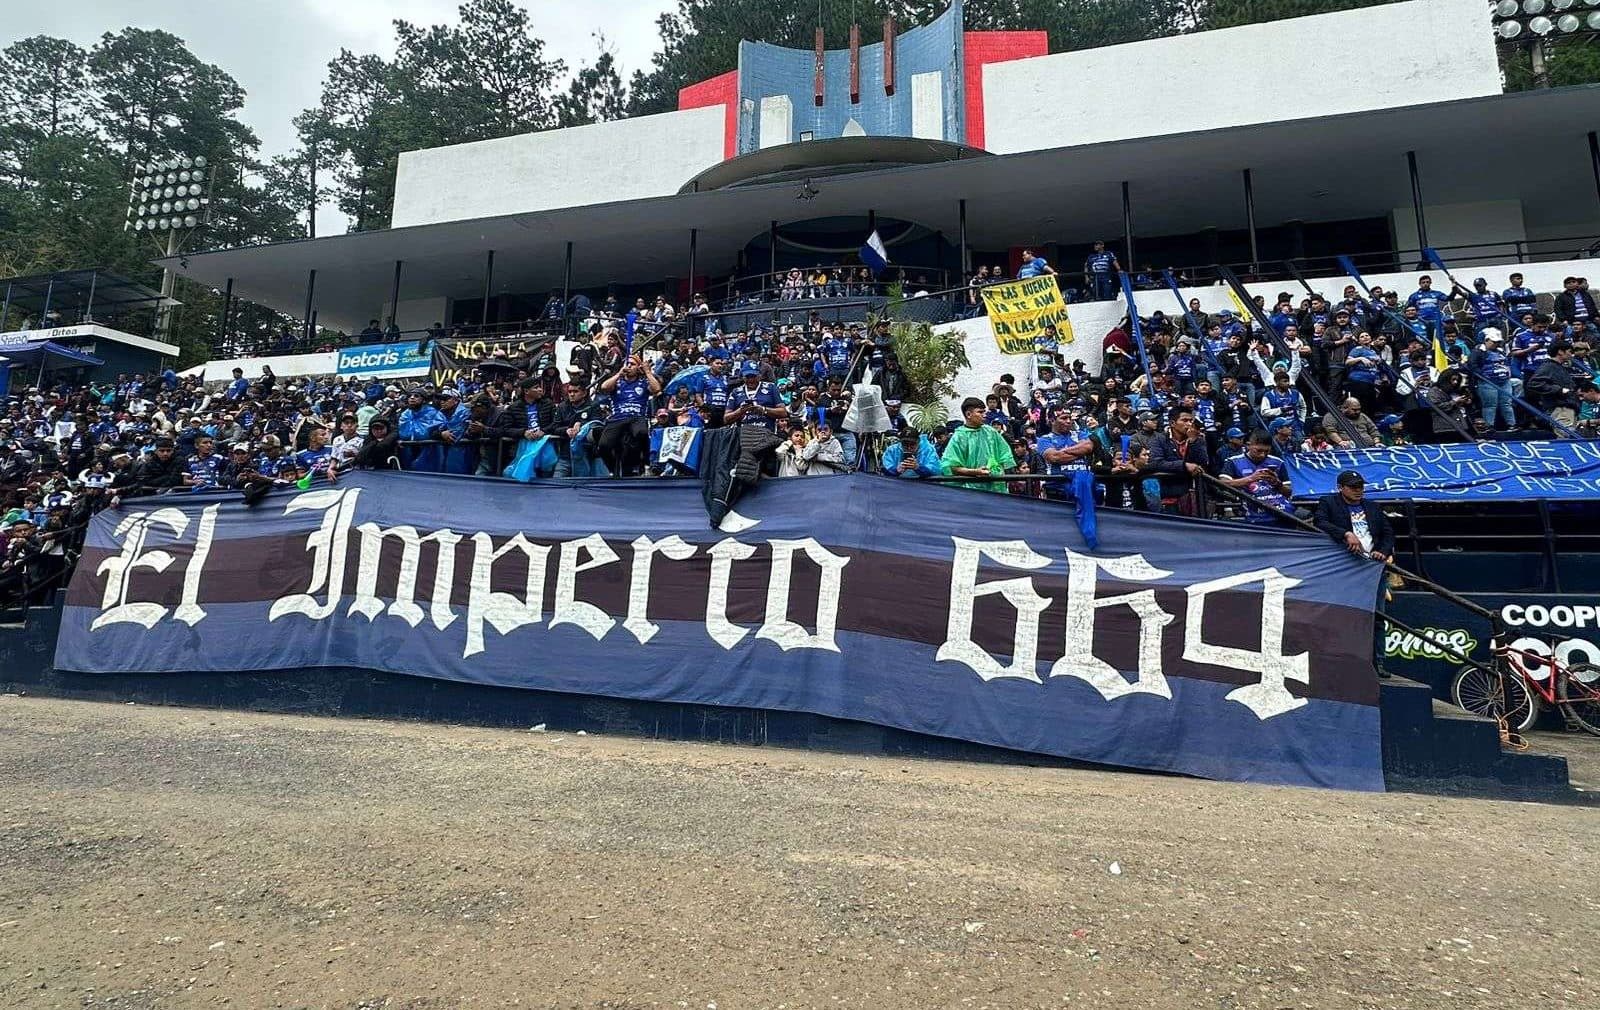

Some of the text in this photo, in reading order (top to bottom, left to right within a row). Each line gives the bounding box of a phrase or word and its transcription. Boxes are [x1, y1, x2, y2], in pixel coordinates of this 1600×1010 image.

[1001, 286, 1018, 299] LAS
[1022, 277, 1054, 296] BUENAS
[1013, 301, 1029, 311] TE
[994, 321, 1010, 335] EN
[1015, 319, 1035, 333] LAS
[340, 349, 399, 369] betcris
[455, 341, 487, 360] NO
[1478, 441, 1563, 460] QUE
[1391, 459, 1573, 482] OLVIDEN
[90, 503, 221, 632] El
[269, 487, 851, 659] Imperio
[1384, 621, 1475, 660] omos
